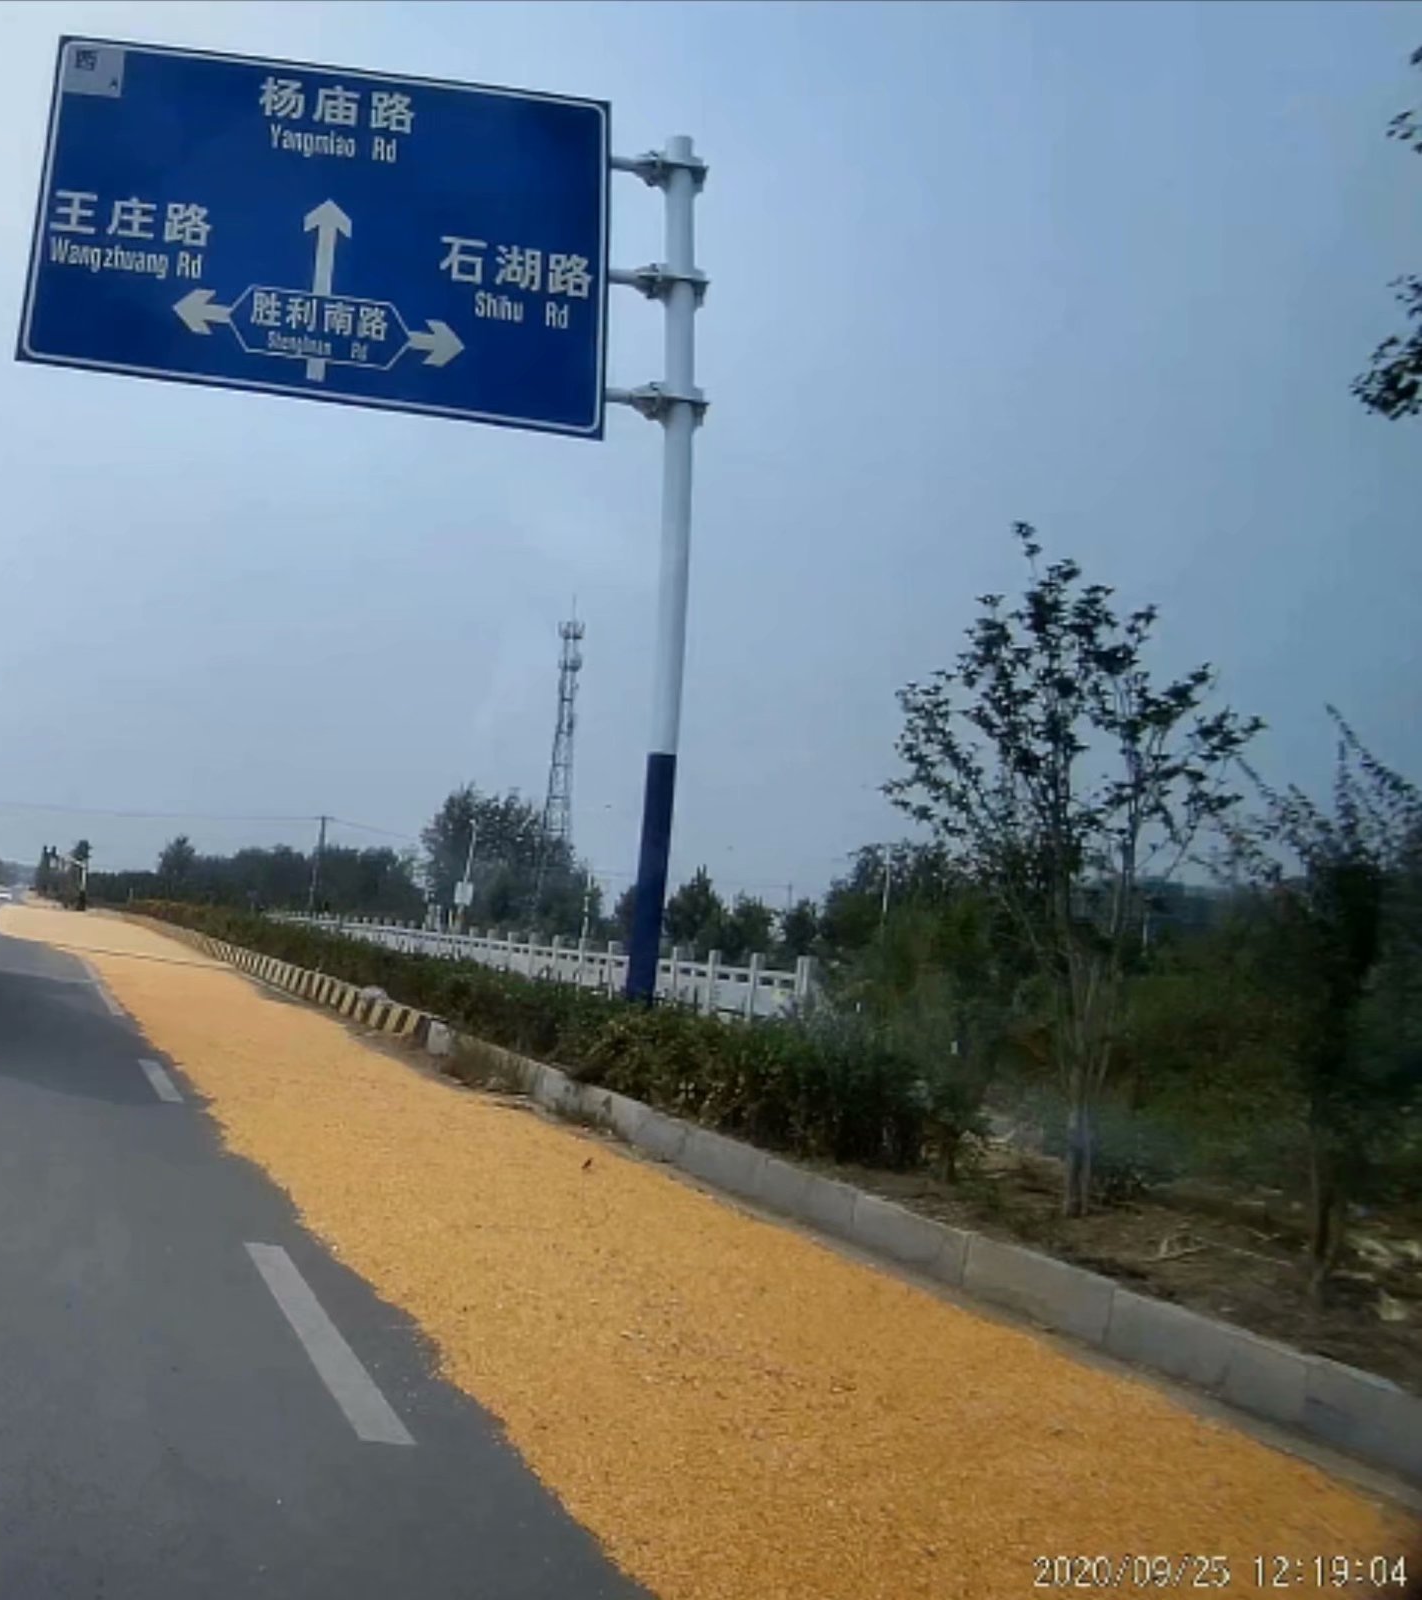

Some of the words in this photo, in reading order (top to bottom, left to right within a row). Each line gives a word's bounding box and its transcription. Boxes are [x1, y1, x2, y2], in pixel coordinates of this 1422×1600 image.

[259, 77, 415, 134] 杨庙路
[270, 123, 356, 158] Yangmiao
[371, 135, 397, 163] Rd
[49, 189, 212, 247] 王庄路
[49, 236, 169, 280] Wangzhuang
[176, 250, 203, 279] Rd
[439, 235, 594, 299] 石湖路
[250, 291, 389, 342] 胜利南路
[474, 289, 524, 323] Shihu
[545, 301, 569, 329] Rd
[350, 341, 369, 361] Rd
